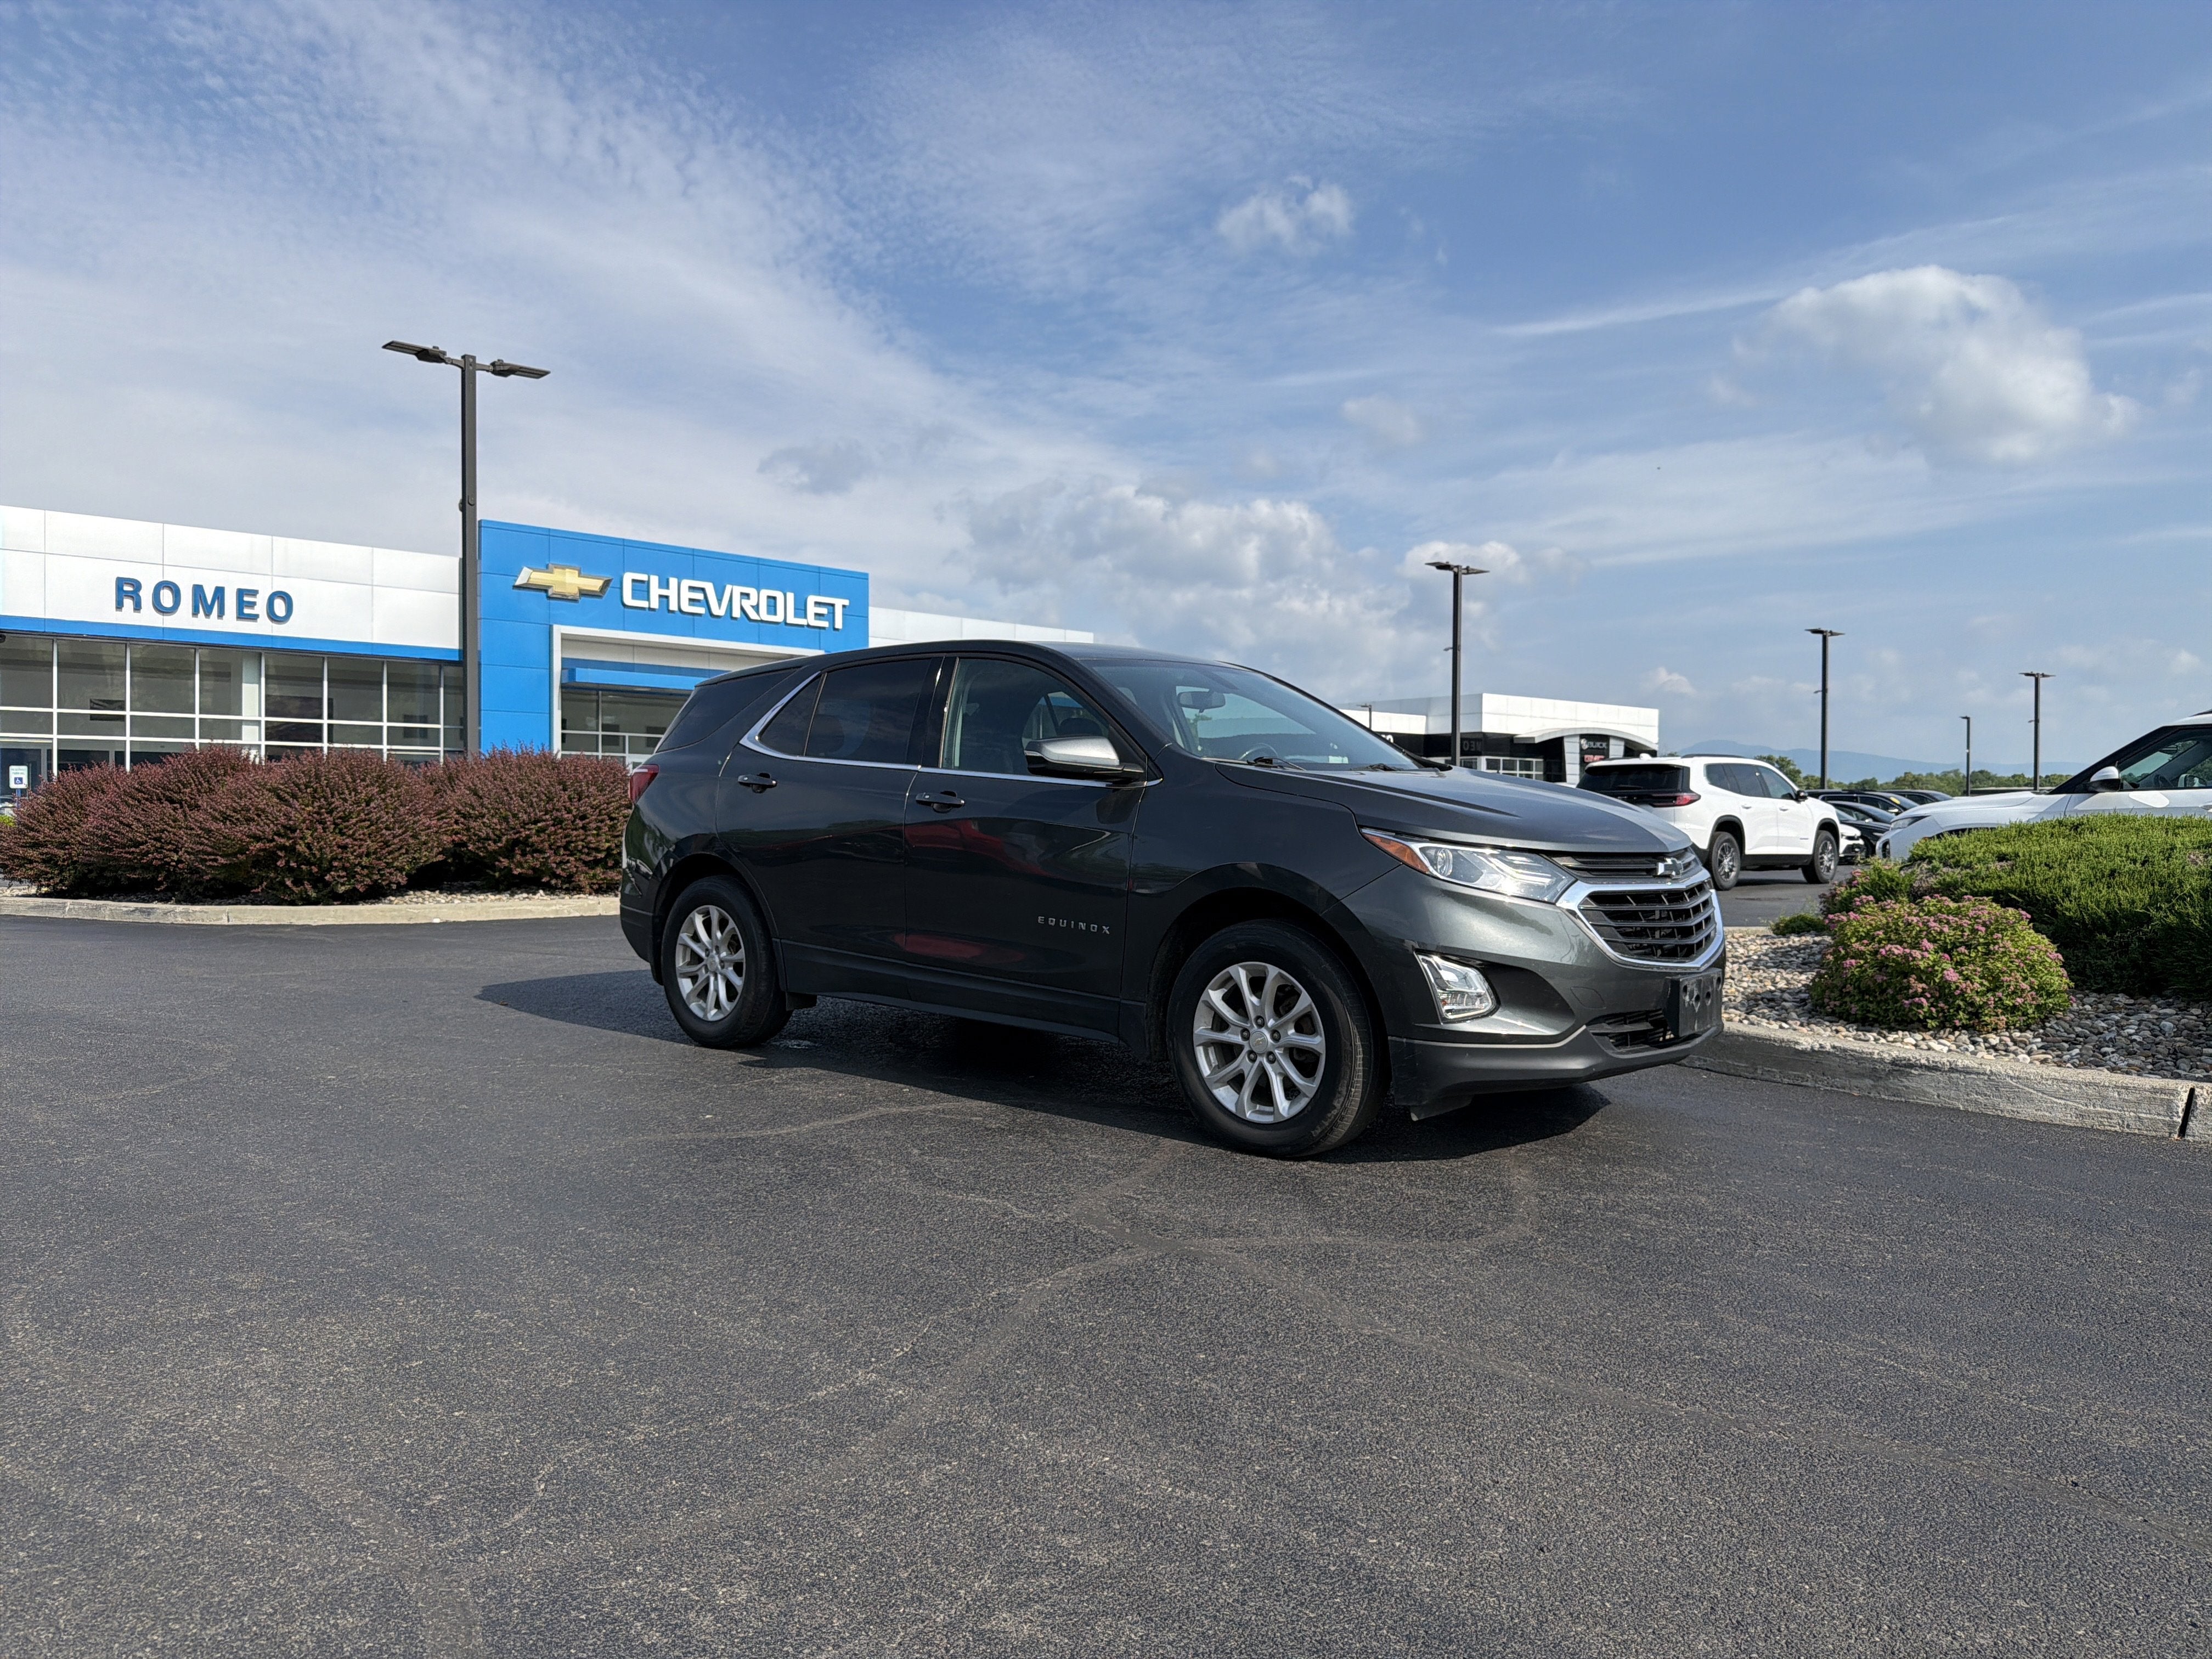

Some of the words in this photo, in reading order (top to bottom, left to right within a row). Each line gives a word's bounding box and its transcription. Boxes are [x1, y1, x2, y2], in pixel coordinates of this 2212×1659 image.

[115, 576, 294, 624] ROMEO
[623, 572, 849, 630] CHEVROLET
[1037, 916, 1110, 934] EQUINOX
